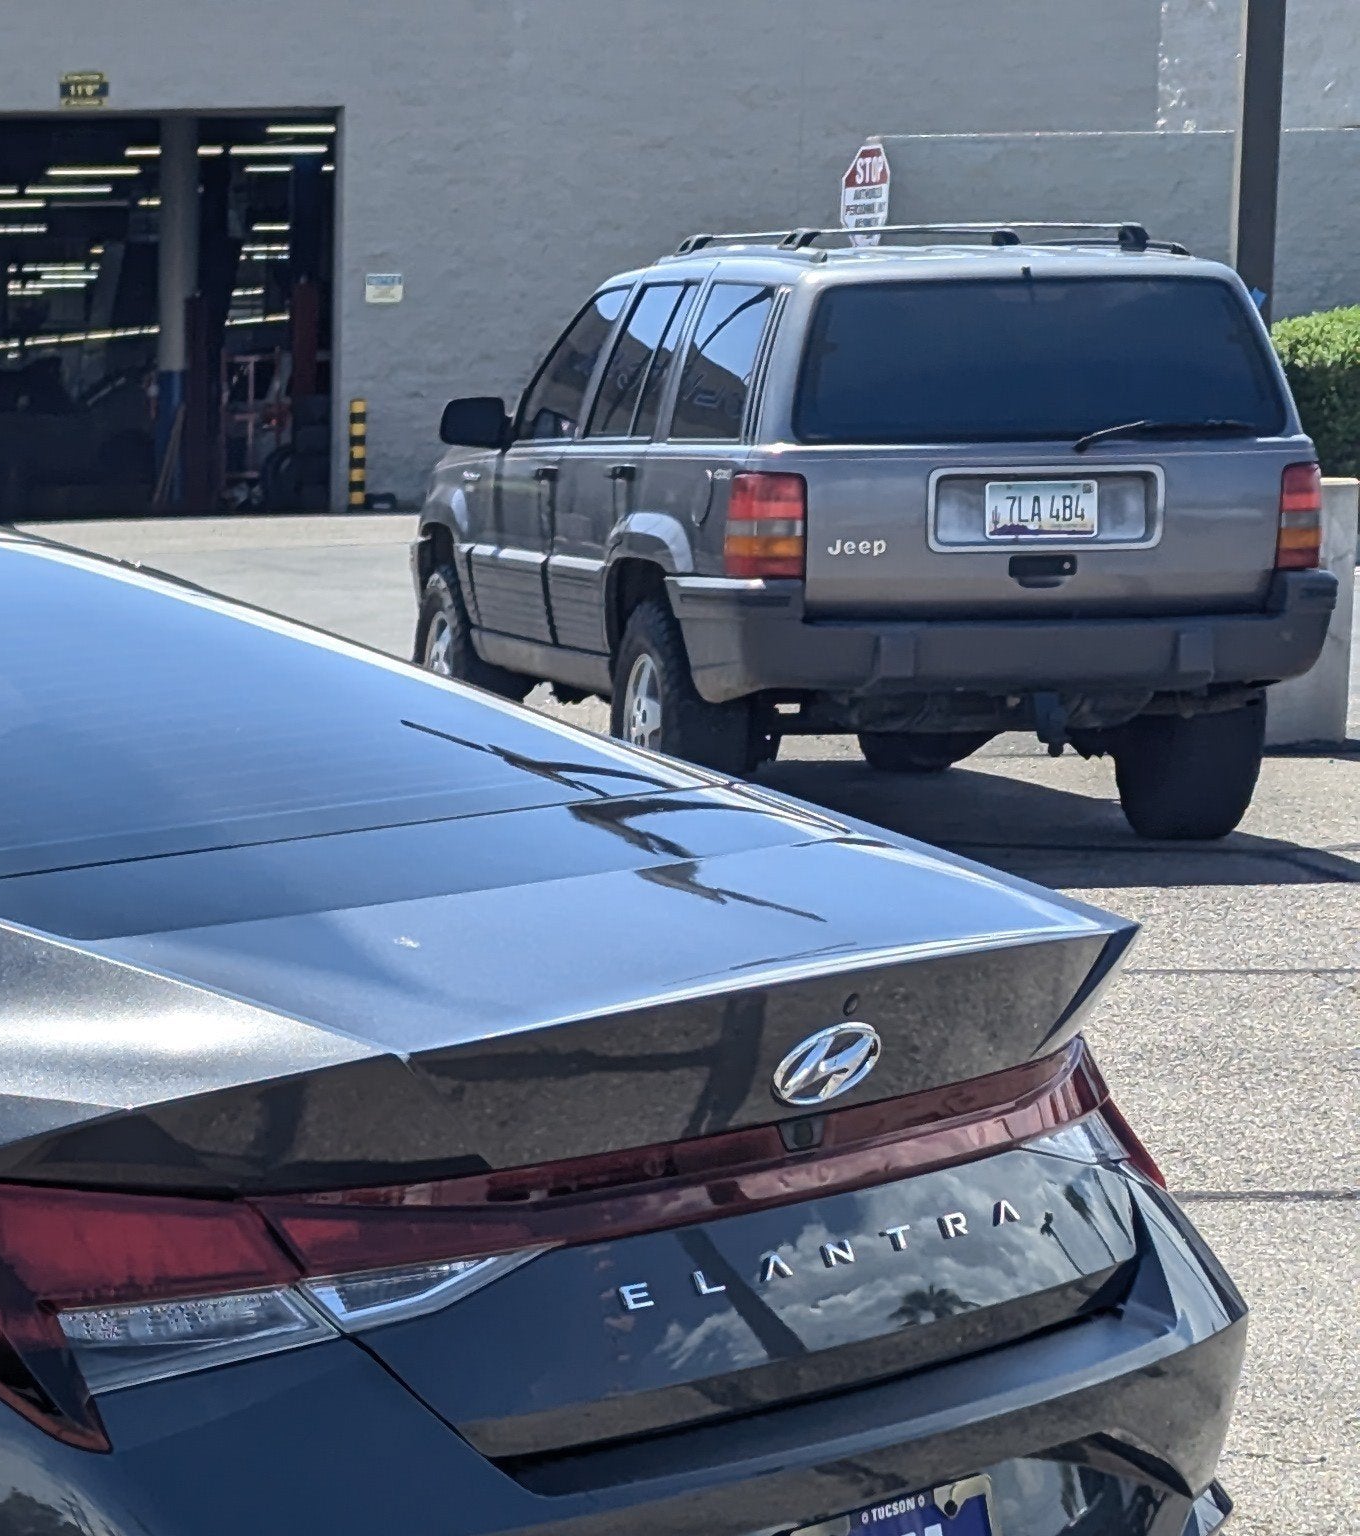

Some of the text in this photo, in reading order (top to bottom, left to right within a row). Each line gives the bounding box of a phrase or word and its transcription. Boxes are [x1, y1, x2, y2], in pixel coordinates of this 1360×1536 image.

[855, 156, 884, 184] STOP
[1005, 494, 1085, 523] 7LA 4B4
[827, 538, 888, 556] Jeep
[619, 1199, 1021, 1310] ELANTRA
[870, 1496, 916, 1522] TUCSON
